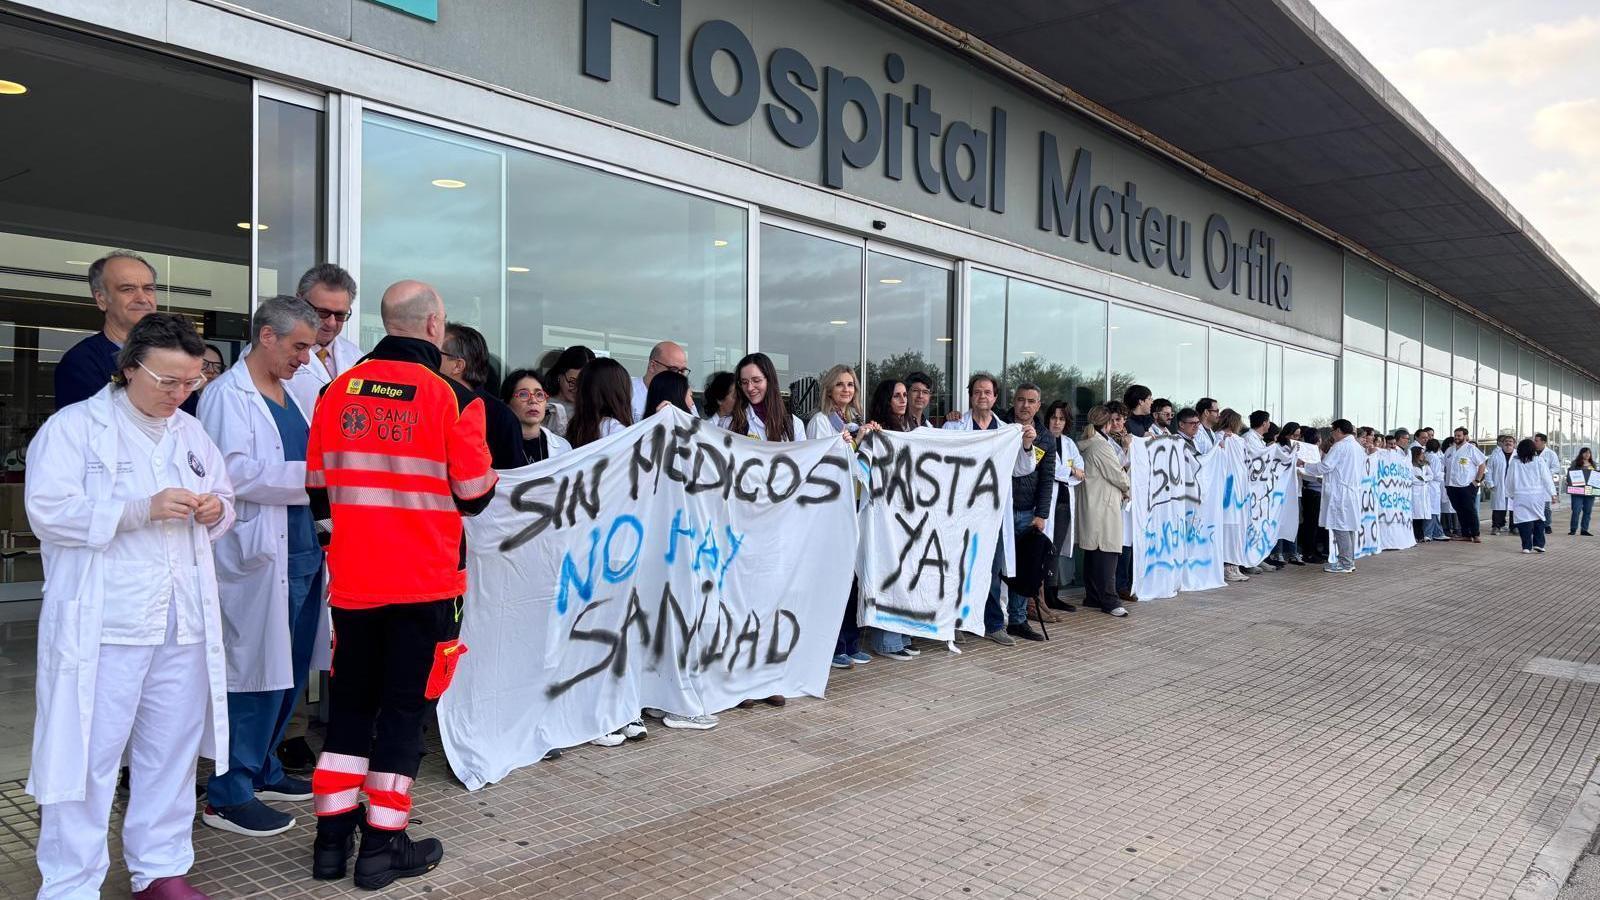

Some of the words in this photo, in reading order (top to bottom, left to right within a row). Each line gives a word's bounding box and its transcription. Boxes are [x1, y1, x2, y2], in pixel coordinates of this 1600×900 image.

[584, 0, 1007, 213] Hospital
[1039, 131, 1191, 278] Mateu
[1204, 213, 1293, 312] Orfila
[372, 384, 403, 397] Metge
[374, 407, 418, 425] SAMU
[377, 423, 413, 442] 061
[500, 455, 609, 552] SIN
[859, 431, 1001, 516] BASTA
[556, 514, 644, 615] NO
[664, 508, 745, 592] HAY
